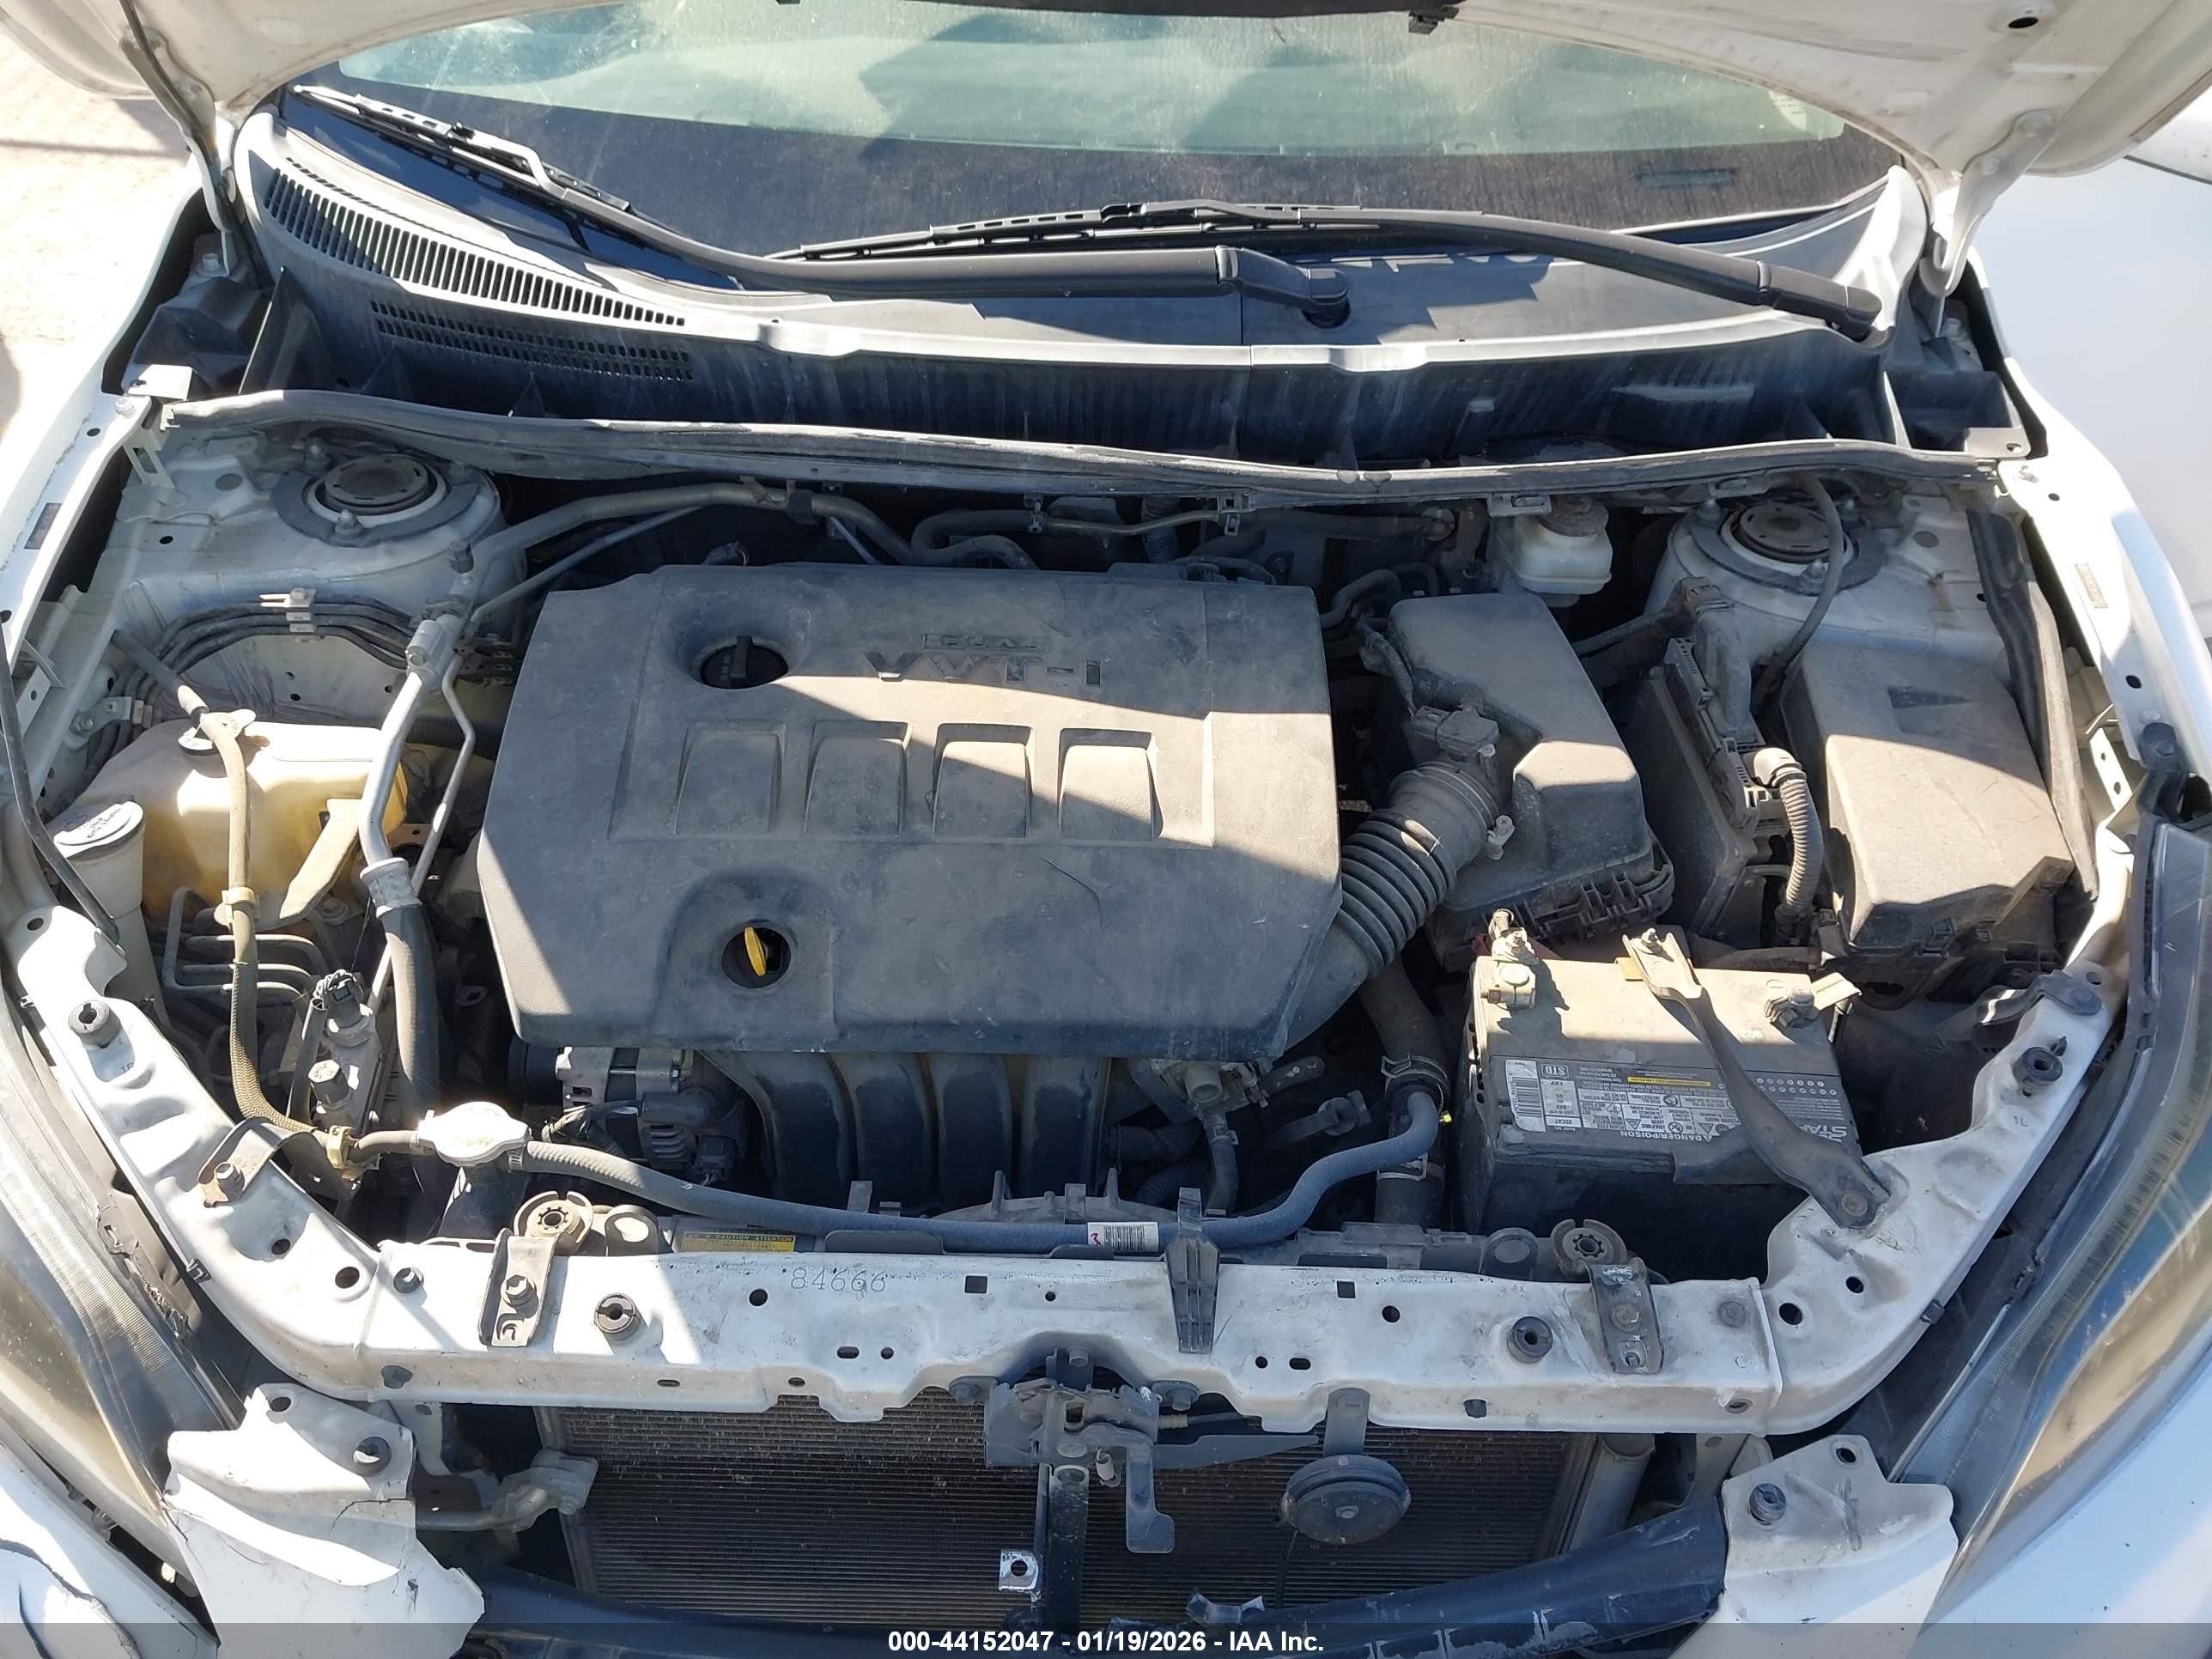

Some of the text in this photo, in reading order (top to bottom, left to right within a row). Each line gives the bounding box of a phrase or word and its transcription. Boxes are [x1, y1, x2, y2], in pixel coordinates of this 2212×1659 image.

[1546, 1066, 1566, 1076] STD
[1620, 1130, 1704, 1142] DANGER/POISON
[790, 1267, 887, 1292] 84666
